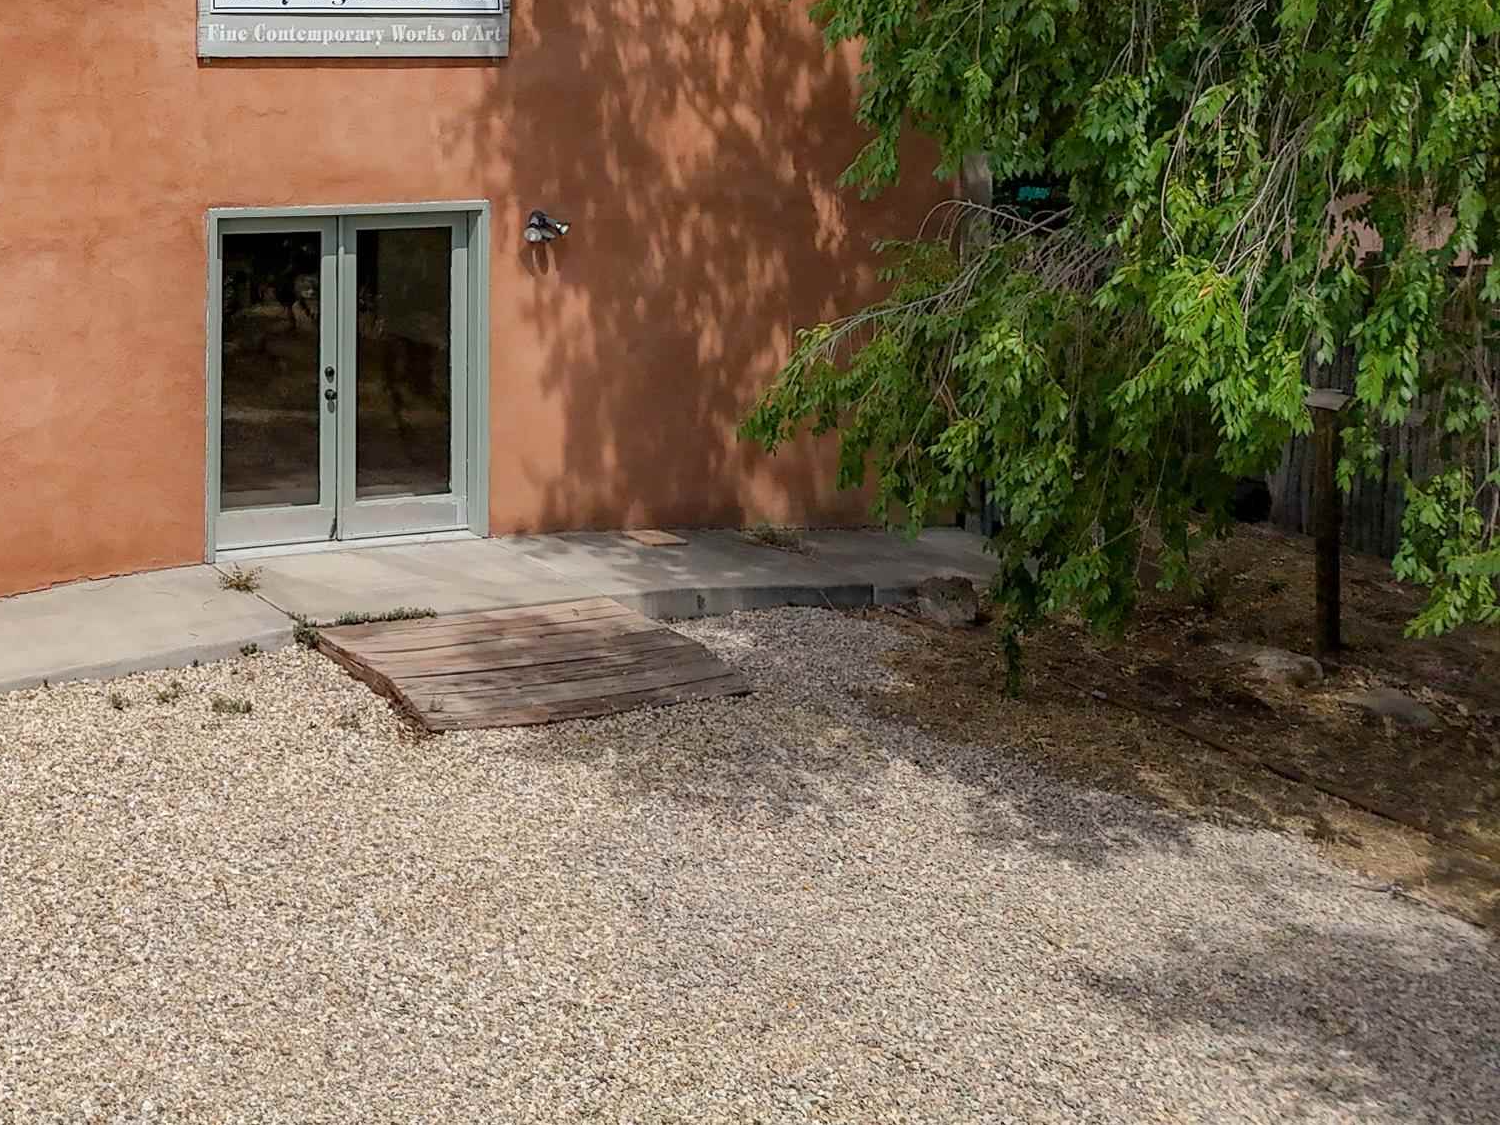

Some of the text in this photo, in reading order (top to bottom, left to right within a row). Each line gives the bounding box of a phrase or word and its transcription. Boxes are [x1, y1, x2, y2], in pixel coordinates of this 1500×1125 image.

[207, 23, 501, 46] Fine Contemporary Works of Art
